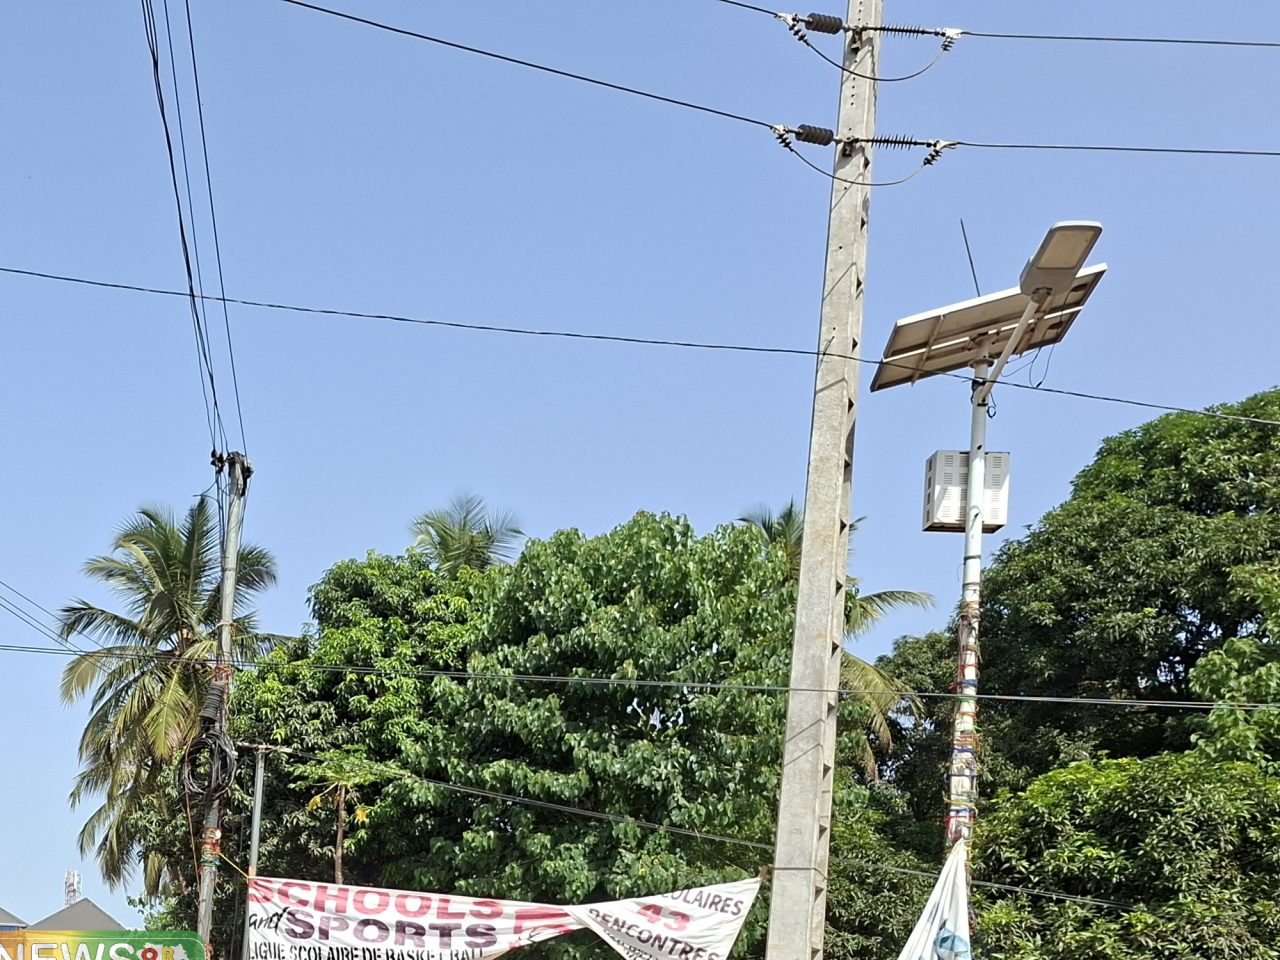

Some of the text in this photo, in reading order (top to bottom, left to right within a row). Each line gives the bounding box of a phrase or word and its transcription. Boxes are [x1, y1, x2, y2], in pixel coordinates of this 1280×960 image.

[249, 879, 504, 920] SCHOOLS
[249, 906, 290, 936] and
[285, 909, 498, 950] SPORTS
[636, 904, 691, 932] 43
[249, 942, 285, 960] LIGUE
